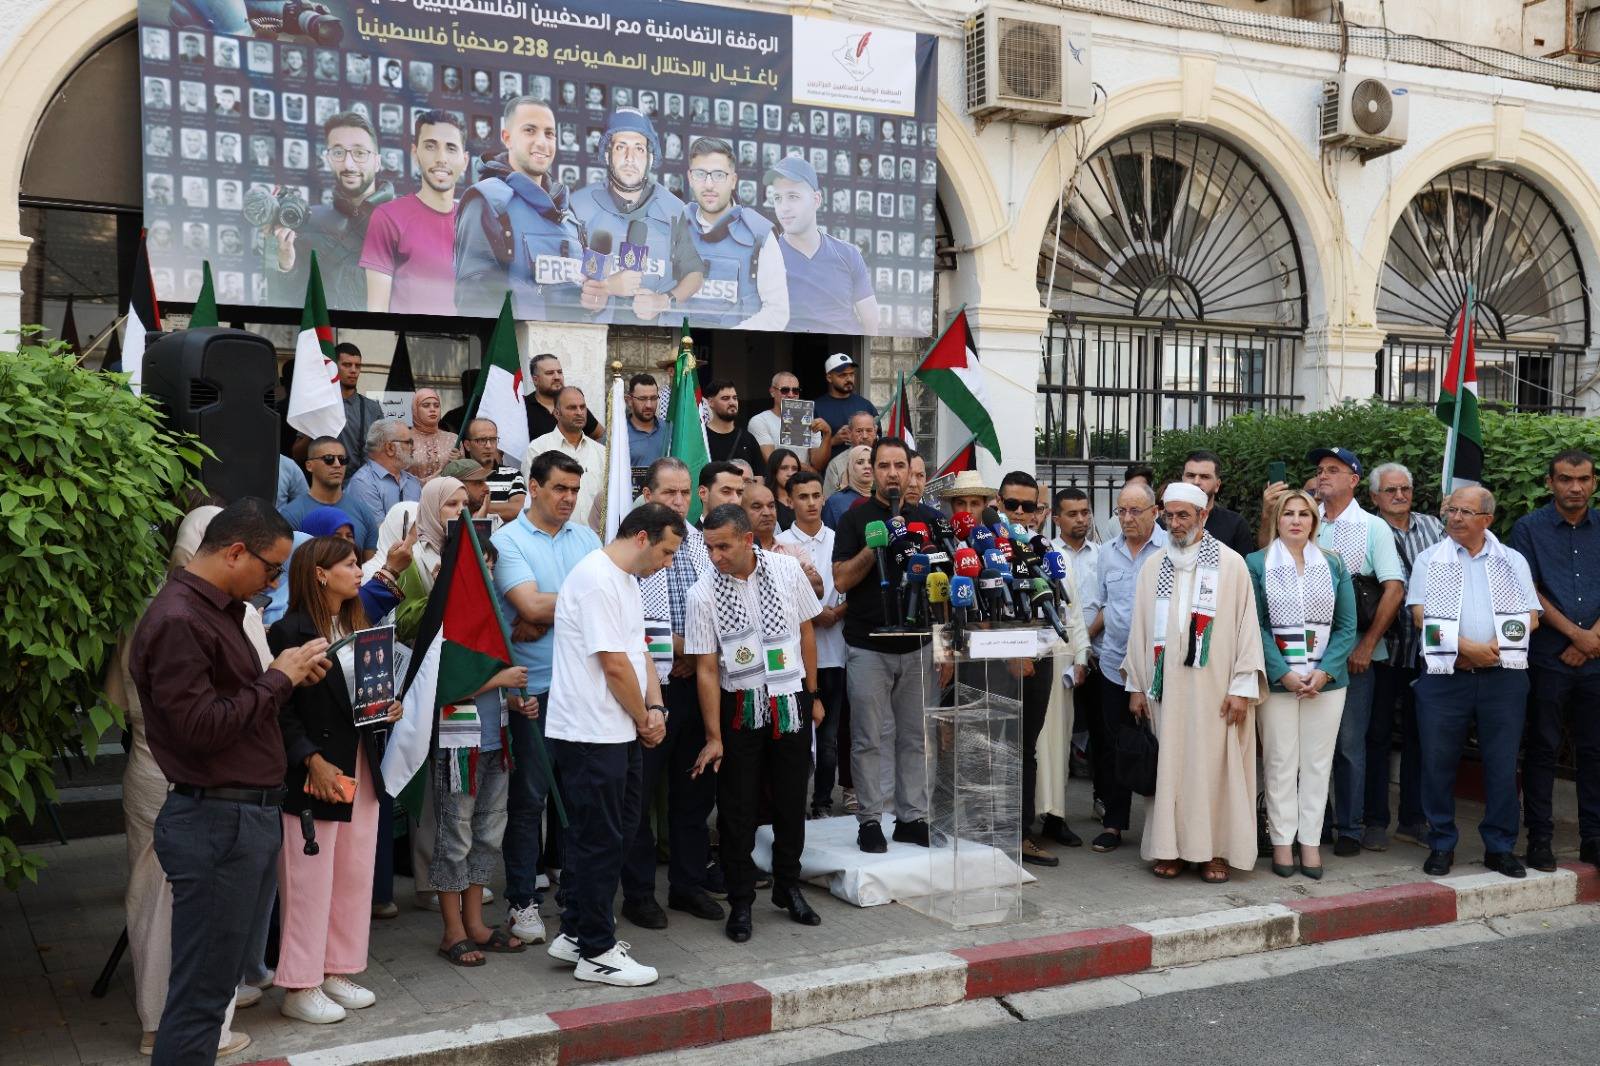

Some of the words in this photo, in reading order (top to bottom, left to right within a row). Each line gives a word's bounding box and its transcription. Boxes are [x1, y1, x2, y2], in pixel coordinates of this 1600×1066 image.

[531, 3, 611, 30] الصحفيين
[614, 19, 641, 35] مع
[645, 18, 722, 45] التضامنية
[726, 30, 778, 55] الوقفة
[513, 35, 549, 58] 238
[553, 45, 647, 70] الصهيوني
[651, 55, 706, 77] الاحتلال
[710, 63, 779, 90] باغتيال
